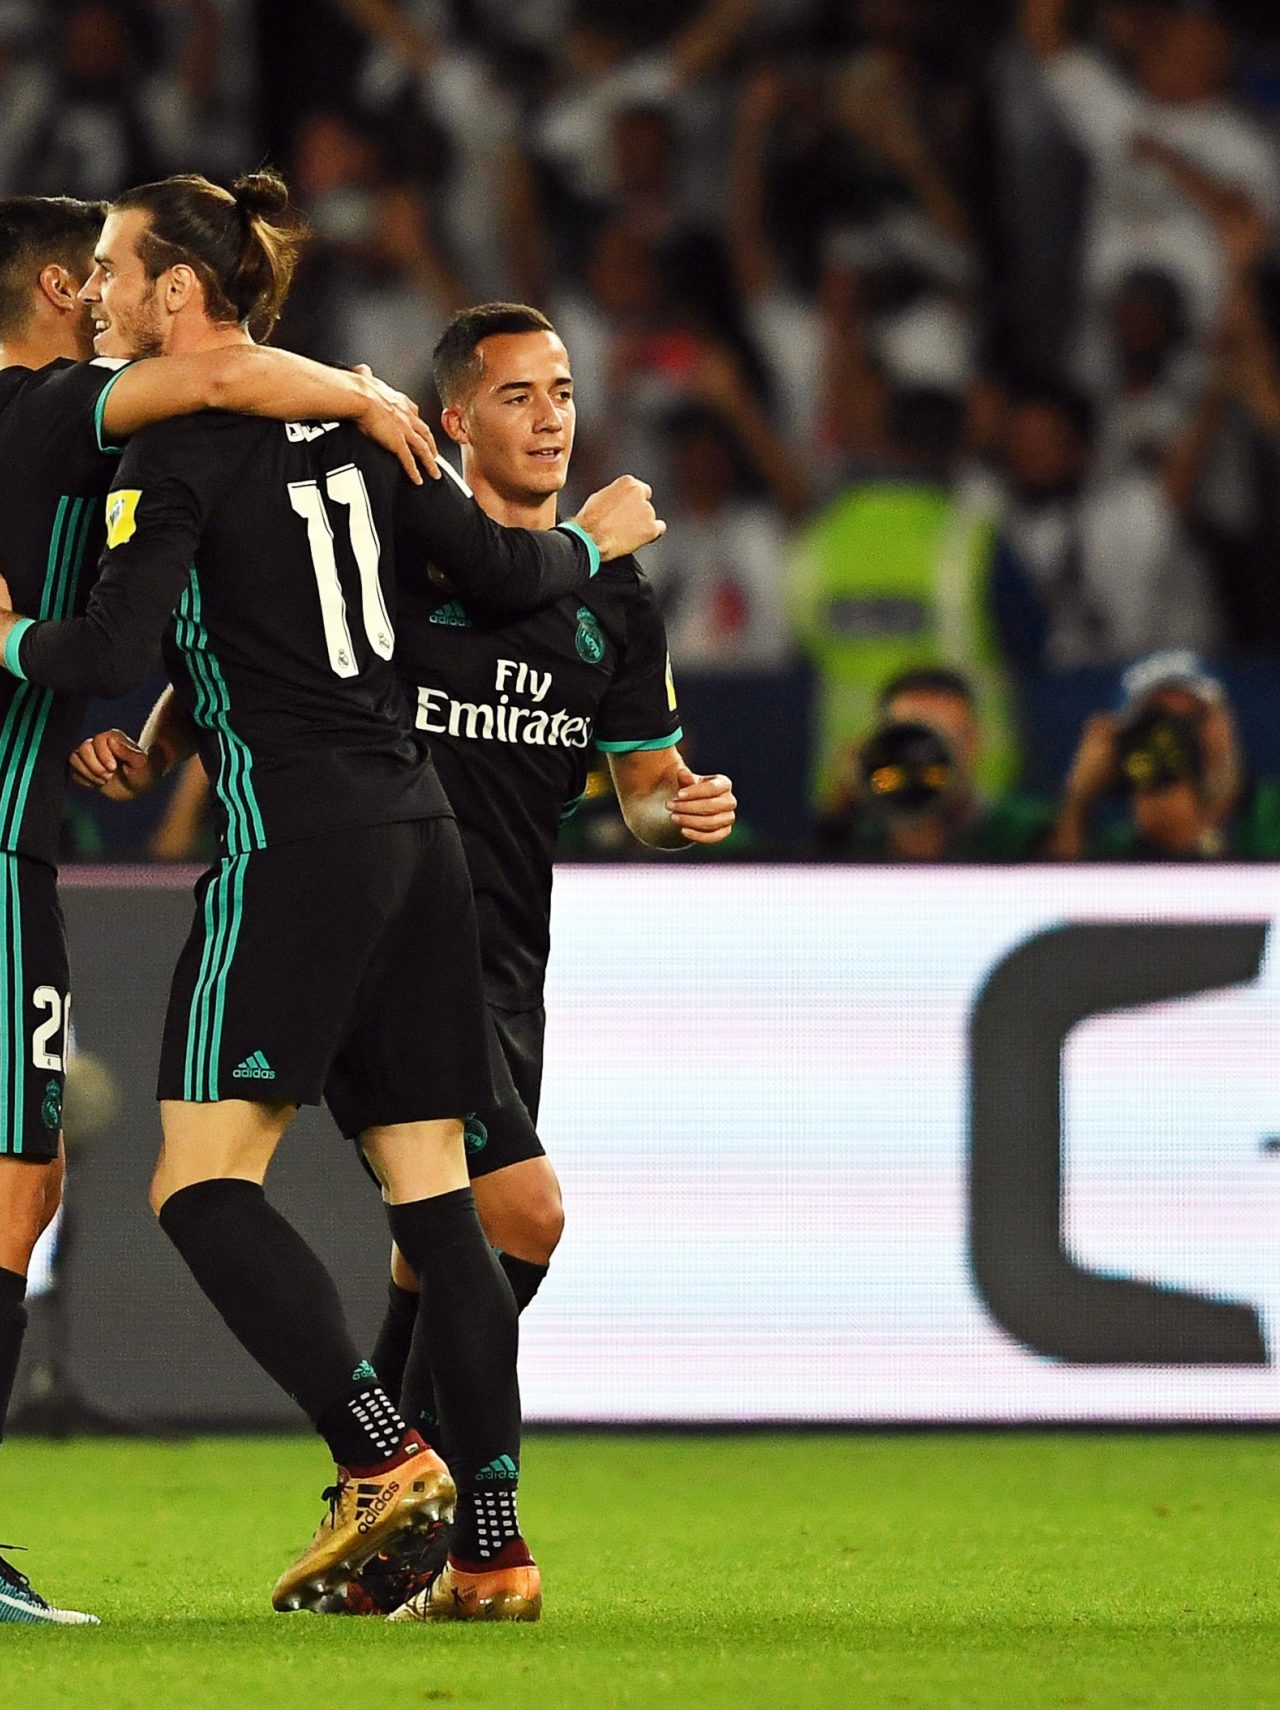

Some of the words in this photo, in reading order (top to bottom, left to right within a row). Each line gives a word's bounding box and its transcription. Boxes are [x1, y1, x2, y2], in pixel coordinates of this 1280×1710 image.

[287, 462, 395, 679] 11
[495, 658, 553, 702] Fly
[415, 685, 592, 749] Emirates
[32, 984, 72, 1076] 2
[232, 1067, 276, 1080] adidas
[357, 1480, 401, 1536] adidas
